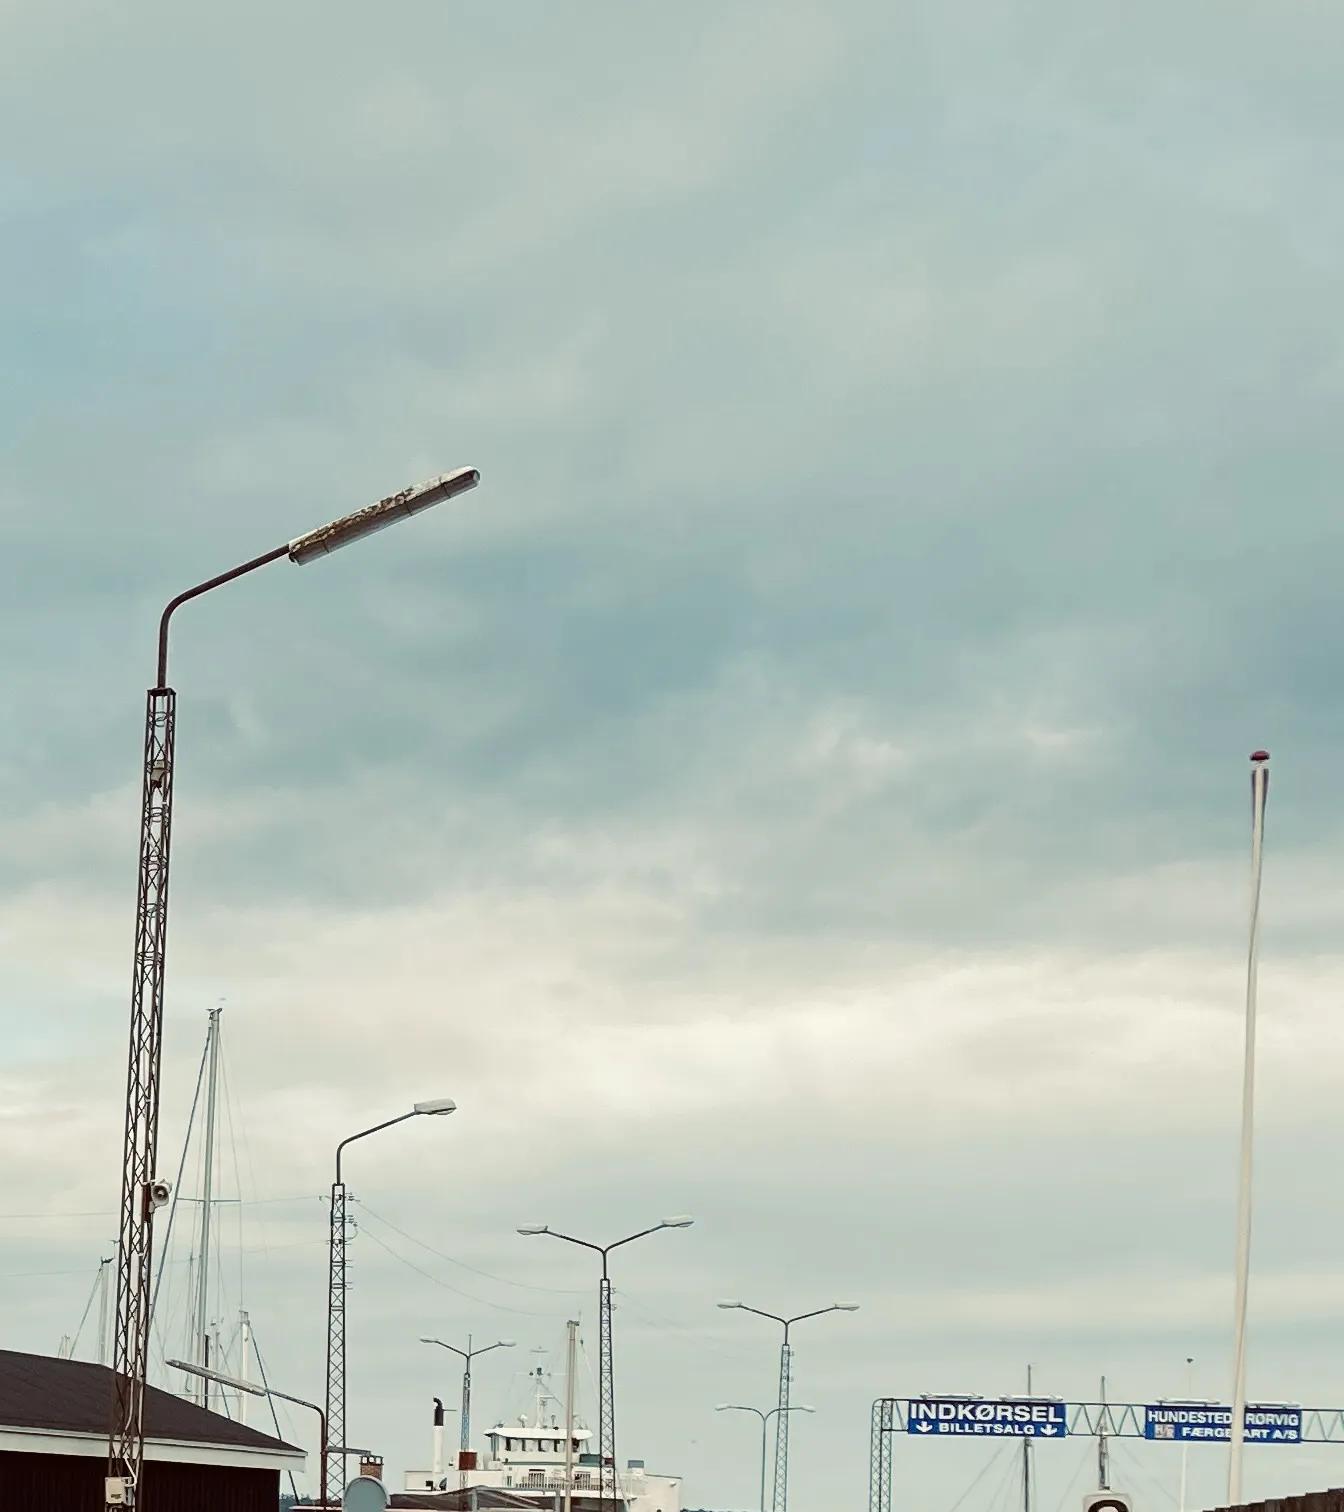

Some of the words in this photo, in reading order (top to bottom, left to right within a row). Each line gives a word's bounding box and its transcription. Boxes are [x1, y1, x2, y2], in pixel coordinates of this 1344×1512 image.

[910, 1403, 1063, 1422] INDKØRSEL
[1148, 1411, 1232, 1424] HUNDESTED
[939, 1422, 1035, 1435] BILLETSALG
[1181, 1427, 1268, 1439] FÆRGEART
[1272, 1428, 1298, 1440] A/S
